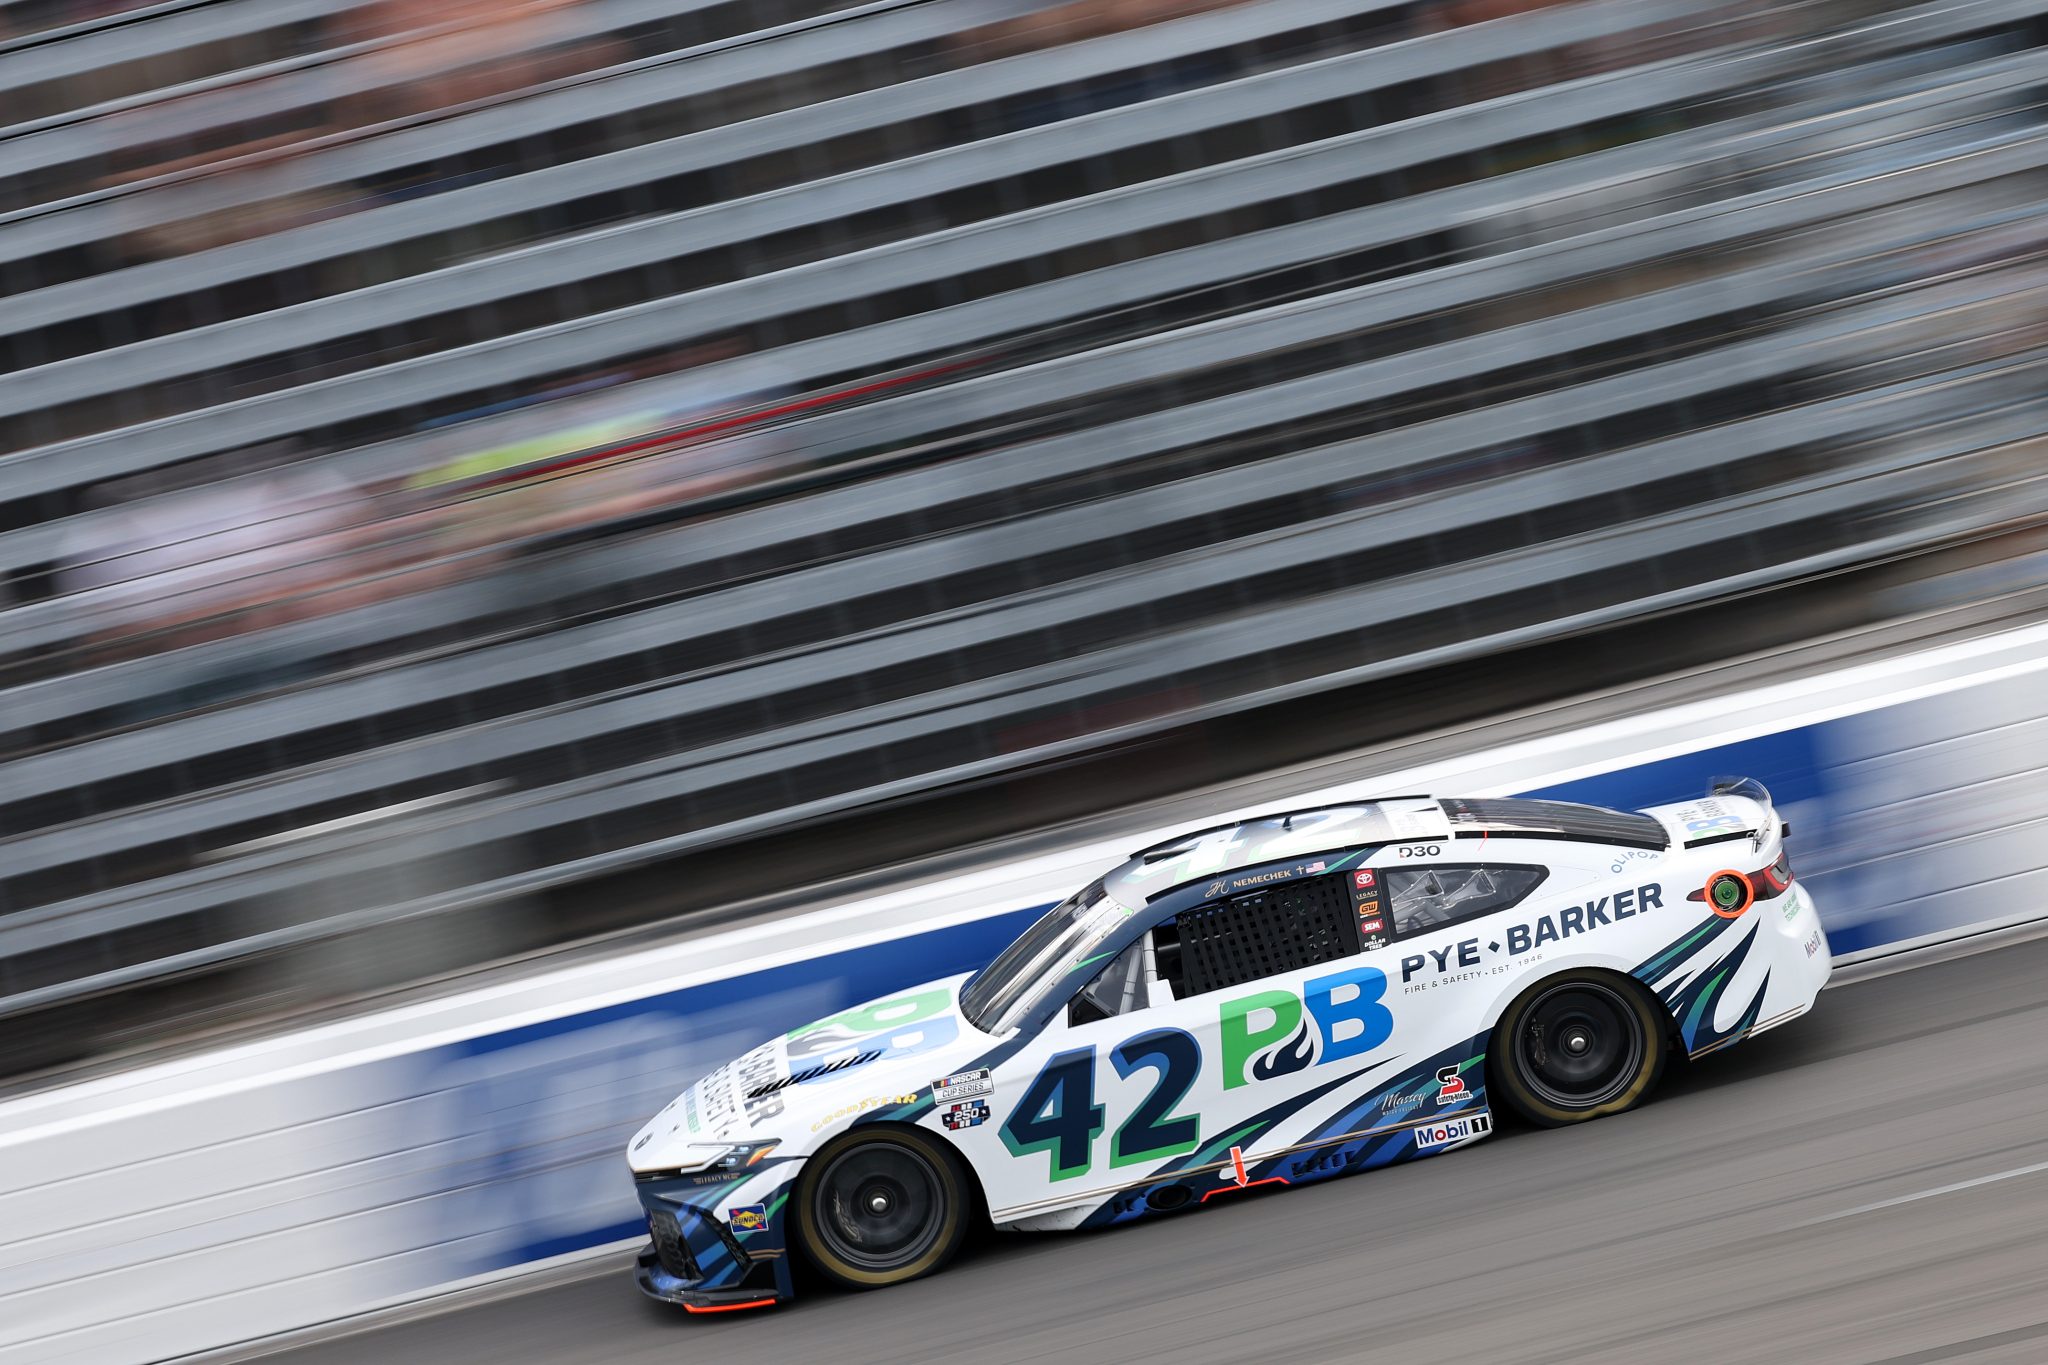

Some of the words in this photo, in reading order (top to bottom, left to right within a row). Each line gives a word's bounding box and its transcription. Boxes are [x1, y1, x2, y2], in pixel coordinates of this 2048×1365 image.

[1611, 851, 1658, 874] OLIPOP
[1233, 869, 1292, 888] NEMECHEK
[1356, 890, 1378, 899] LEGACY
[1364, 921, 1380, 931] SEM
[1401, 937, 1481, 983] PYE
[1506, 882, 1664, 957] BARKER
[1364, 938, 1386, 948] DOLLAR
[1404, 981, 1427, 995] FIRE
[1432, 979, 1438, 988] &
[1443, 970, 1482, 985] SAFETY
[1492, 964, 1513, 975] EST.
[1518, 953, 1543, 967] 1946
[1220, 966, 1394, 1092] PB
[950, 1071, 981, 1086] NASCAR
[942, 1087, 958, 1098] CUP
[958, 1082, 984, 1095] SERIES
[998, 1026, 1203, 1184] 42
[1374, 1091, 1426, 1110] Massey
[811, 1093, 918, 1133] GOODYEAR
[954, 1107, 979, 1122] 250
[1417, 1120, 1469, 1145] Mobil
[732, 1213, 765, 1226] SUNOCO
